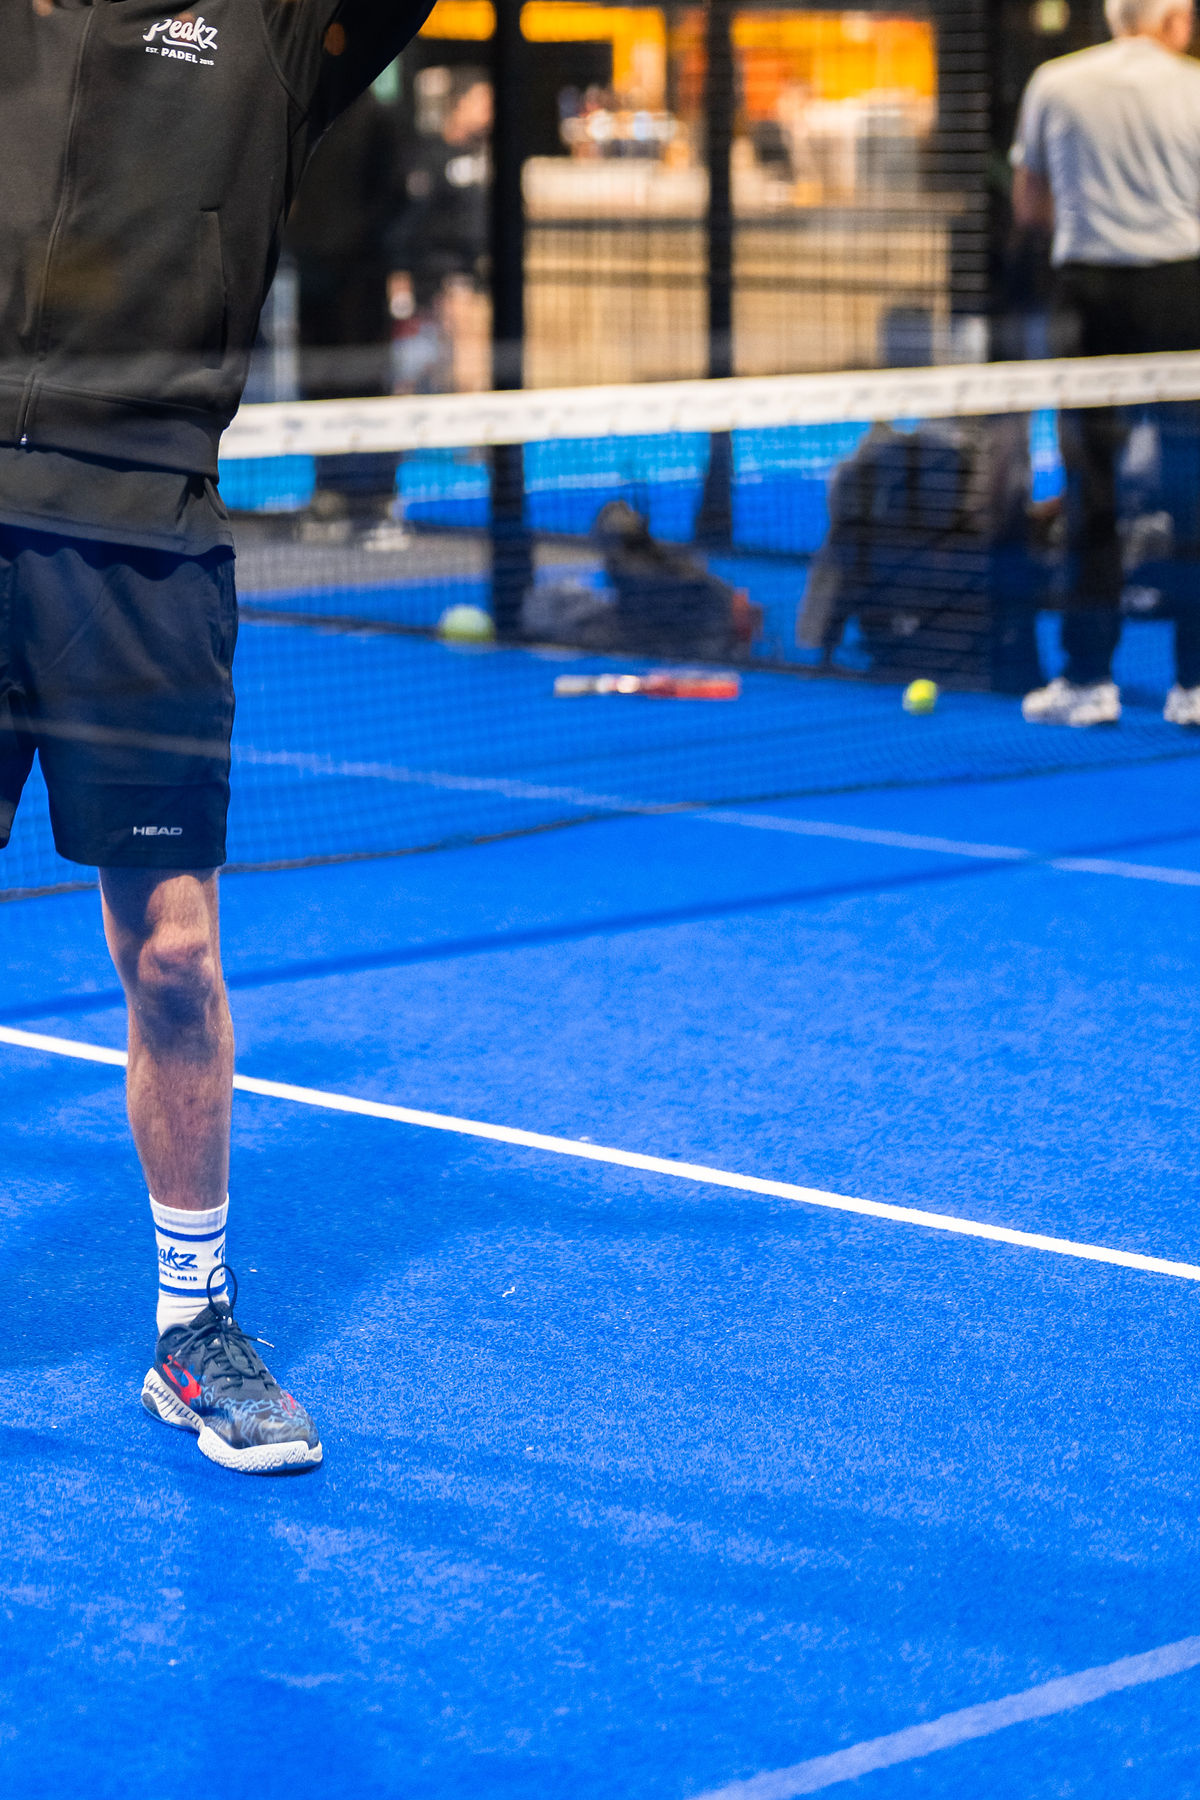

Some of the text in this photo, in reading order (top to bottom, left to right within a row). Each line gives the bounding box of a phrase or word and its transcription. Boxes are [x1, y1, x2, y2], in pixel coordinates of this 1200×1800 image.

[142, 17, 218, 51] Peakz
[145, 46, 159, 54] EST.
[161, 47, 198, 64] PADEL
[133, 826, 183, 836] HEAD
